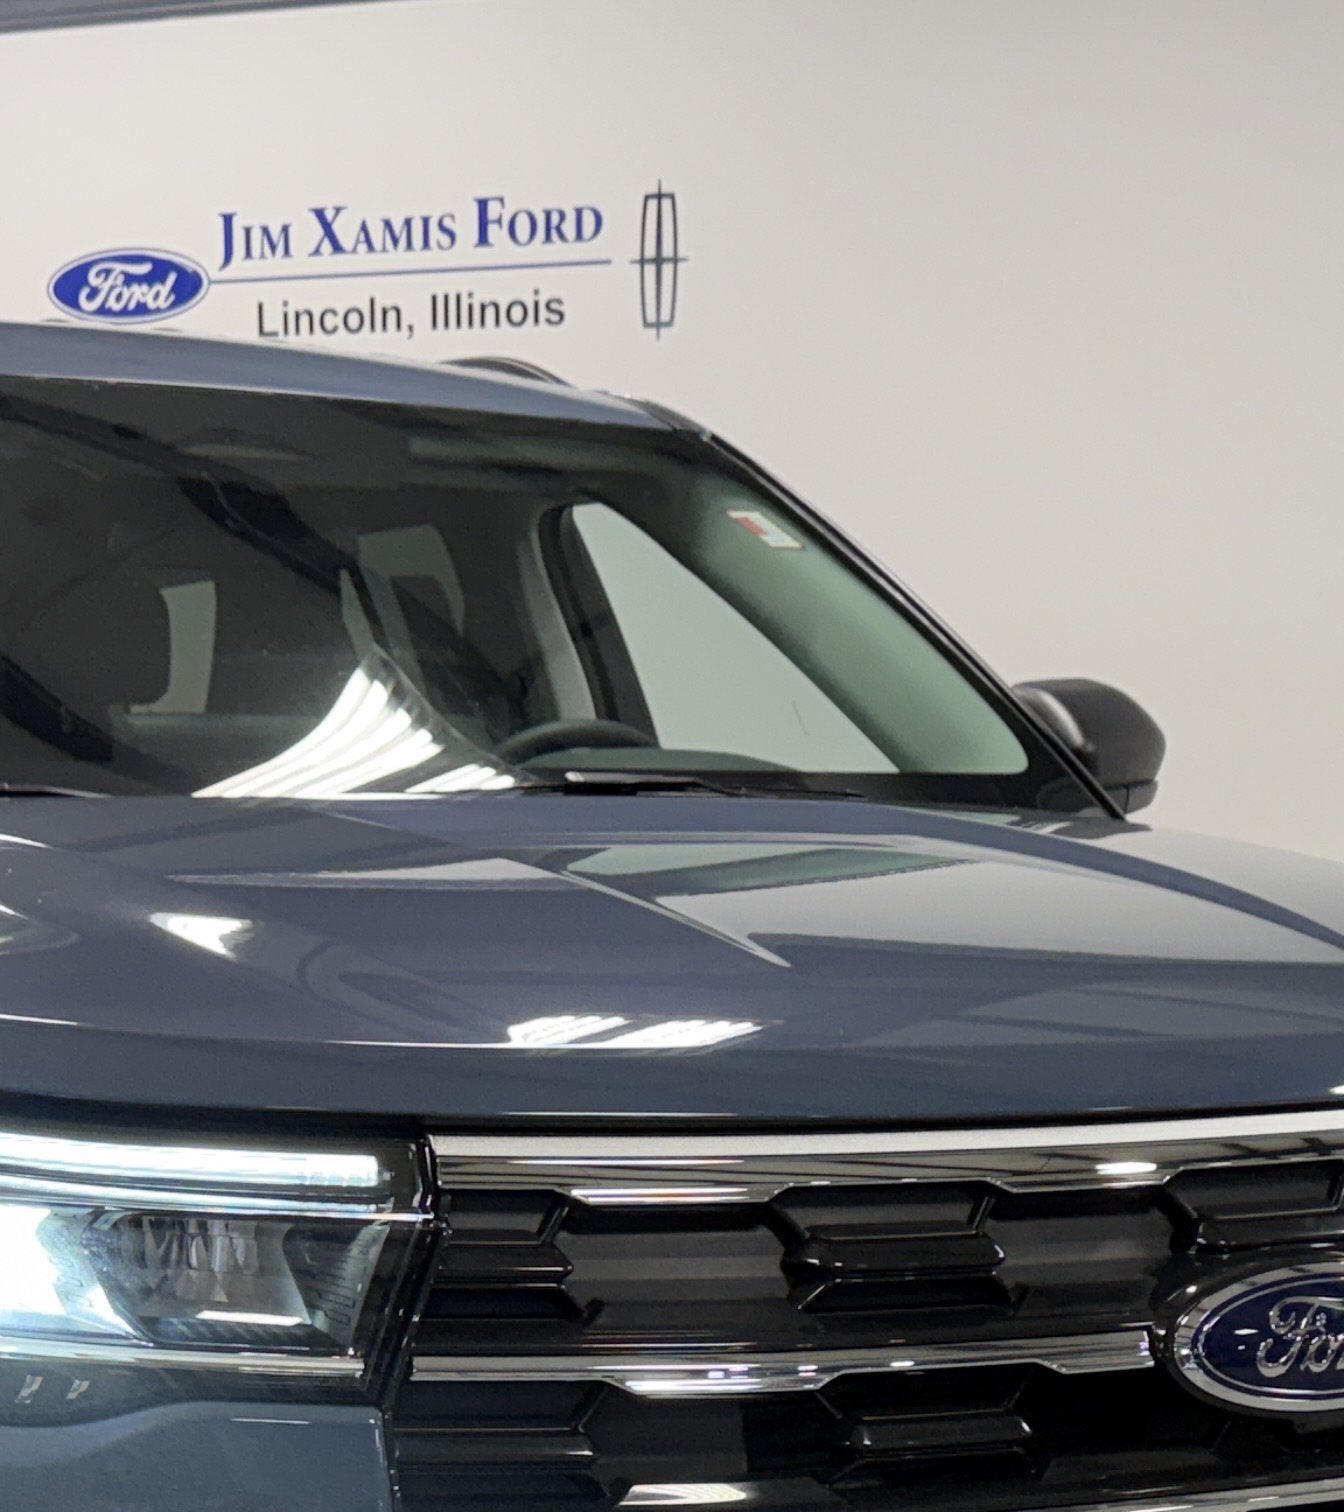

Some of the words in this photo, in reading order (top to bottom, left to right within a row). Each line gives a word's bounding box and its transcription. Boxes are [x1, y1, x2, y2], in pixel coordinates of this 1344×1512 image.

[216, 212, 293, 270] JIM
[307, 206, 457, 257] XAMIS
[472, 196, 603, 248] FORD
[78, 262, 177, 313] Ford
[257, 297, 415, 339] Lincoln,
[430, 289, 566, 332] Illinois
